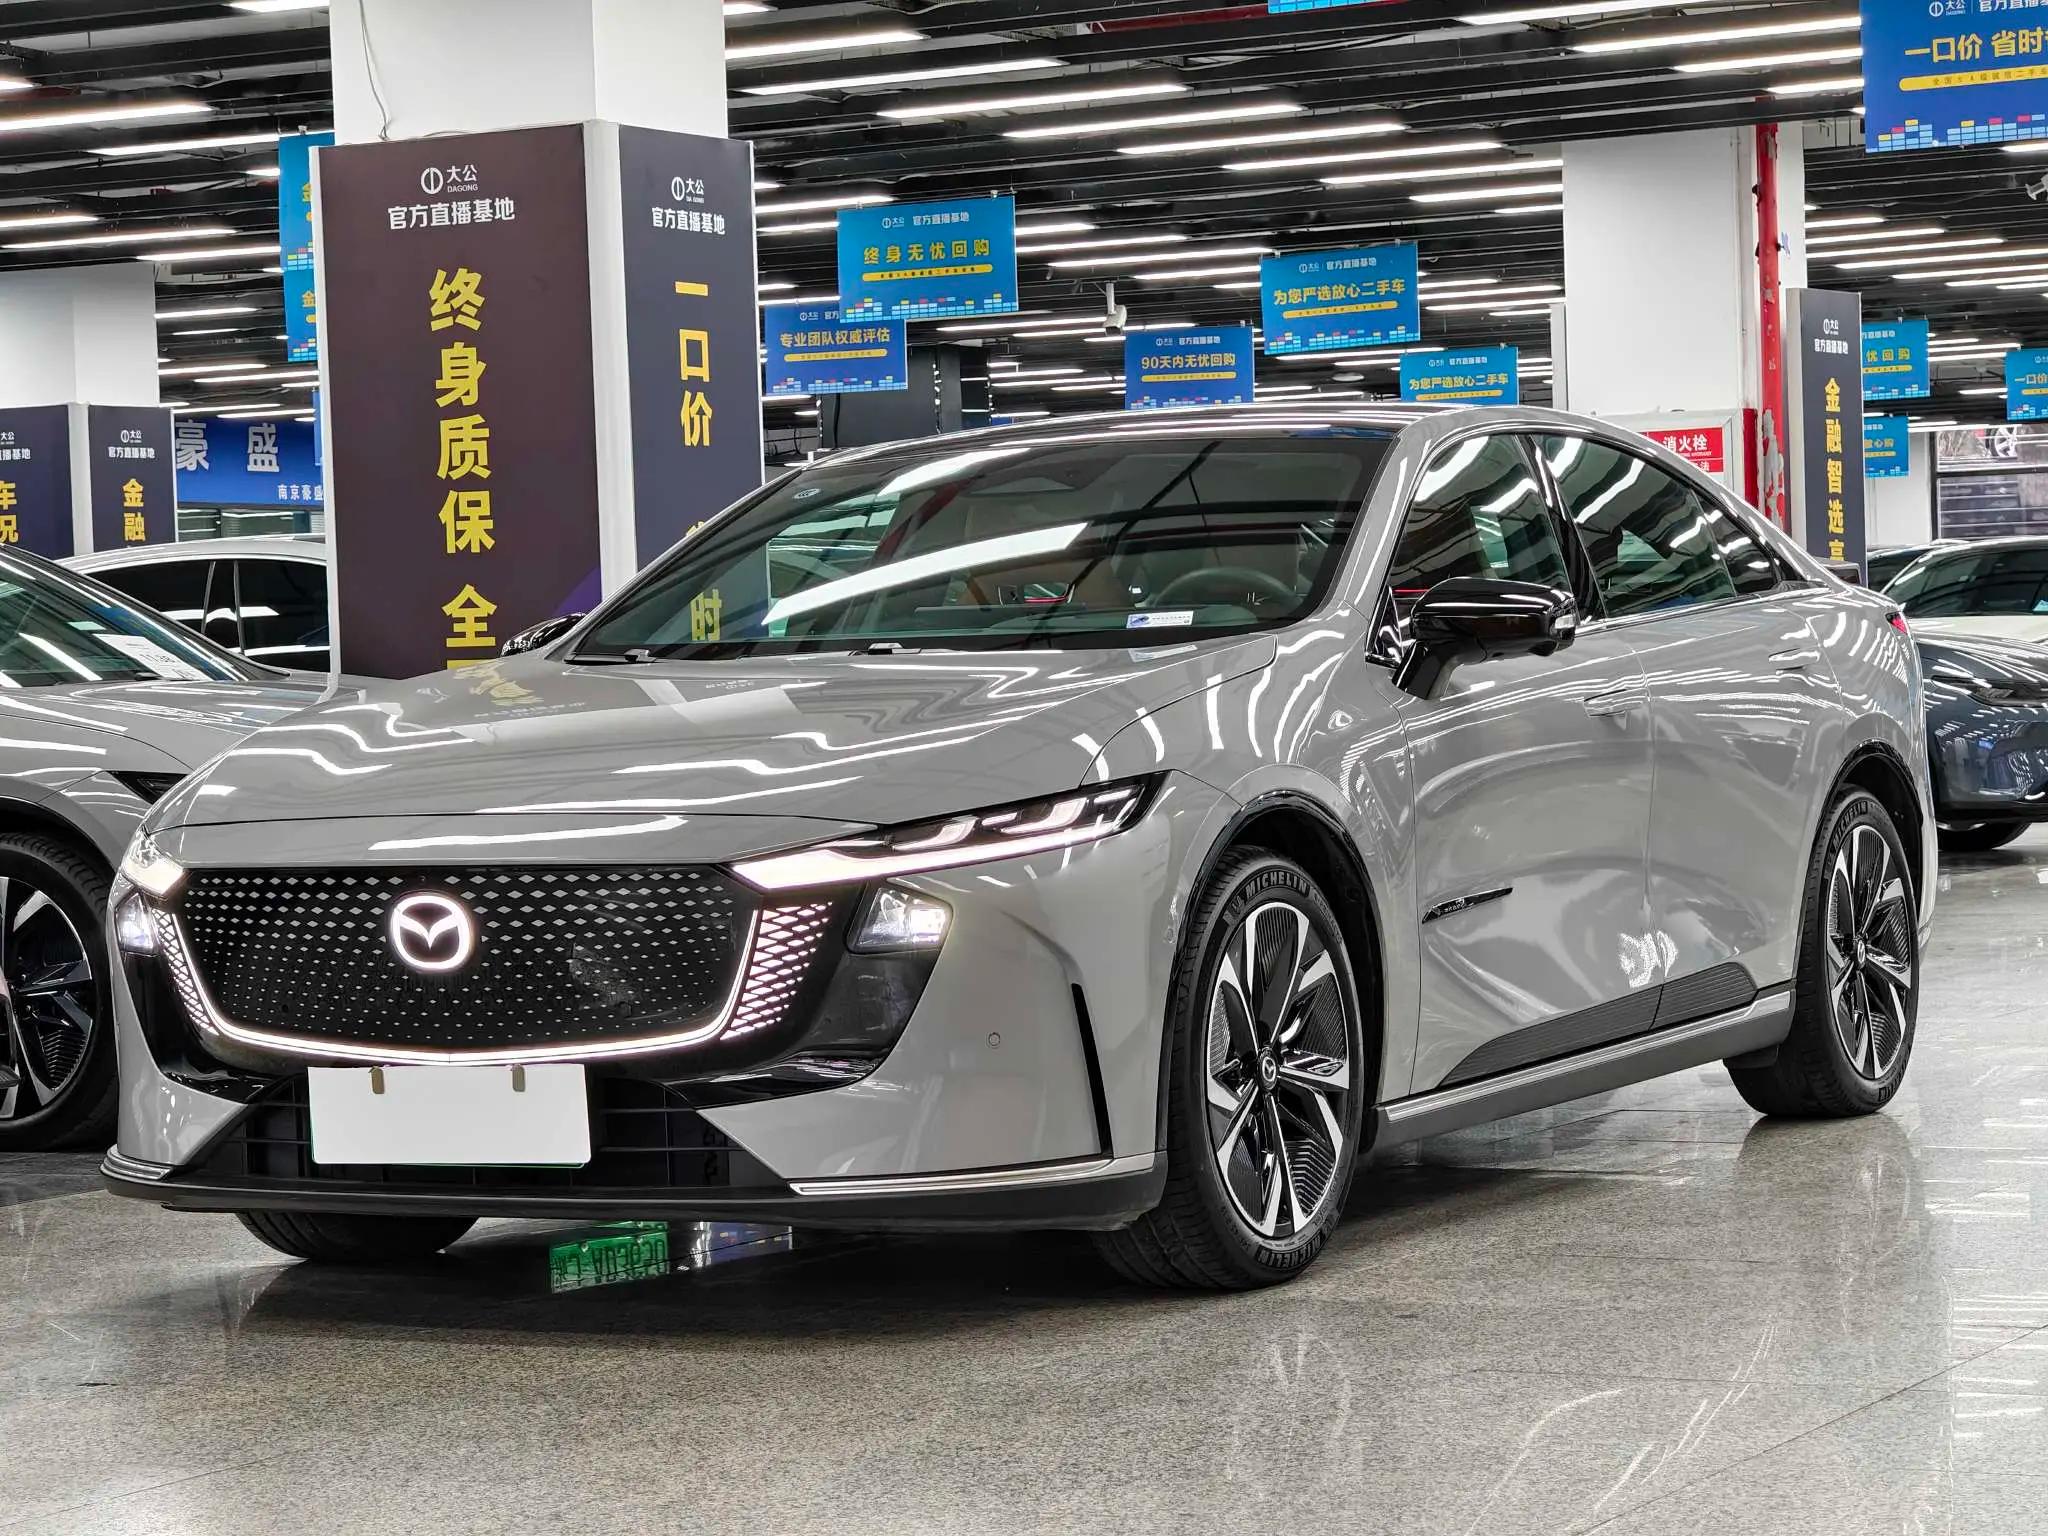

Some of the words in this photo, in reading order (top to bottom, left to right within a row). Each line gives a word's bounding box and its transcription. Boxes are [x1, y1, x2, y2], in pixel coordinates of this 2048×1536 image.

[1905, 33, 1983, 62] 一口价
[1991, 26, 2048, 57] 省时
[446, 164, 478, 183] 大公
[685, 178, 705, 196] 大公
[447, 184, 478, 193] DAGONG
[387, 196, 516, 230] 官方直播基地
[651, 206, 726, 235] 官方直播基地
[1273, 278, 1406, 306] 为您严选放心二手车
[780, 327, 891, 348] 专业团队权威评估
[675, 280, 713, 447] 一口价
[429, 267, 496, 554] 终身质保
[0, 447, 31, 461] 播基地
[175, 419, 280, 473] 豪盛
[1662, 433, 1708, 453] 消火栓
[122, 478, 146, 542] 金融
[441, 583, 498, 669] 全
[1245, 871, 1308, 899] MICHELIN
